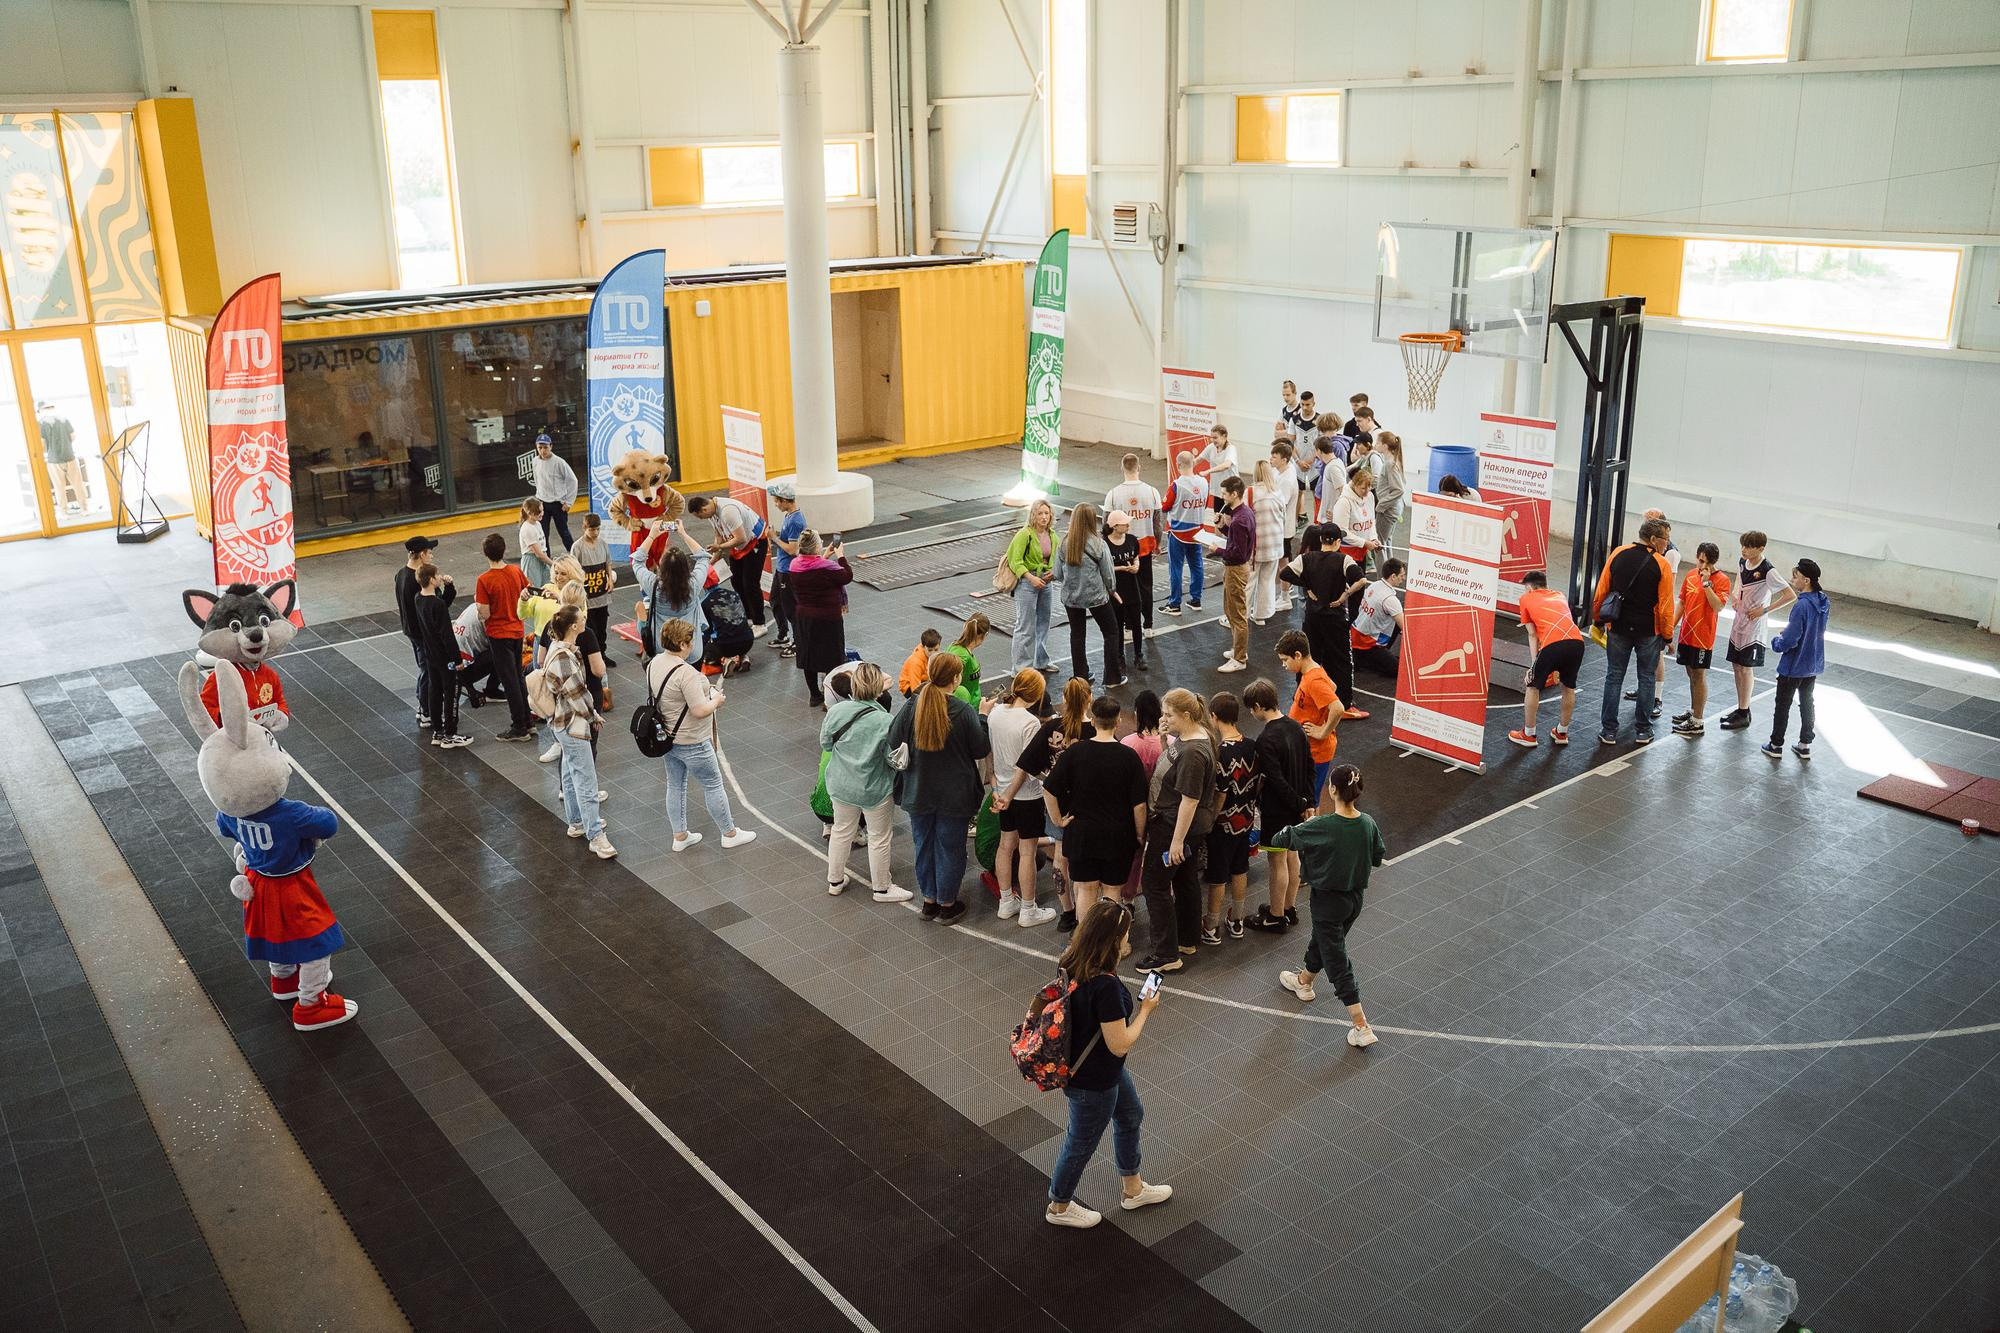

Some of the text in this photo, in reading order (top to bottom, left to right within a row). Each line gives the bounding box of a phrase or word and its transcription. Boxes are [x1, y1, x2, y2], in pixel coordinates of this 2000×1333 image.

[1040, 264, 1063, 297] ГТО
[601, 294, 650, 331] ГТО
[222, 328, 272, 371] ГТО
[282, 343, 405, 373] ОРАДРОМ
[633, 352, 649, 360] ГТО
[1303, 436, 1309, 444] 5
[1483, 461, 1548, 480] Наклон вперед
[259, 520, 288, 544] ГТО
[1433, 560, 1470, 575] Сгибание
[1415, 579, 1438, 591] упоре
[1439, 585, 1460, 596] лежа
[1460, 590, 1471, 598] на
[1471, 593, 1492, 605] полу
[1425, 570, 1471, 587] разгибание
[1470, 581, 1484, 590] рук
[1752, 648, 1757, 660] 1
[237, 817, 274, 850] ГТО
